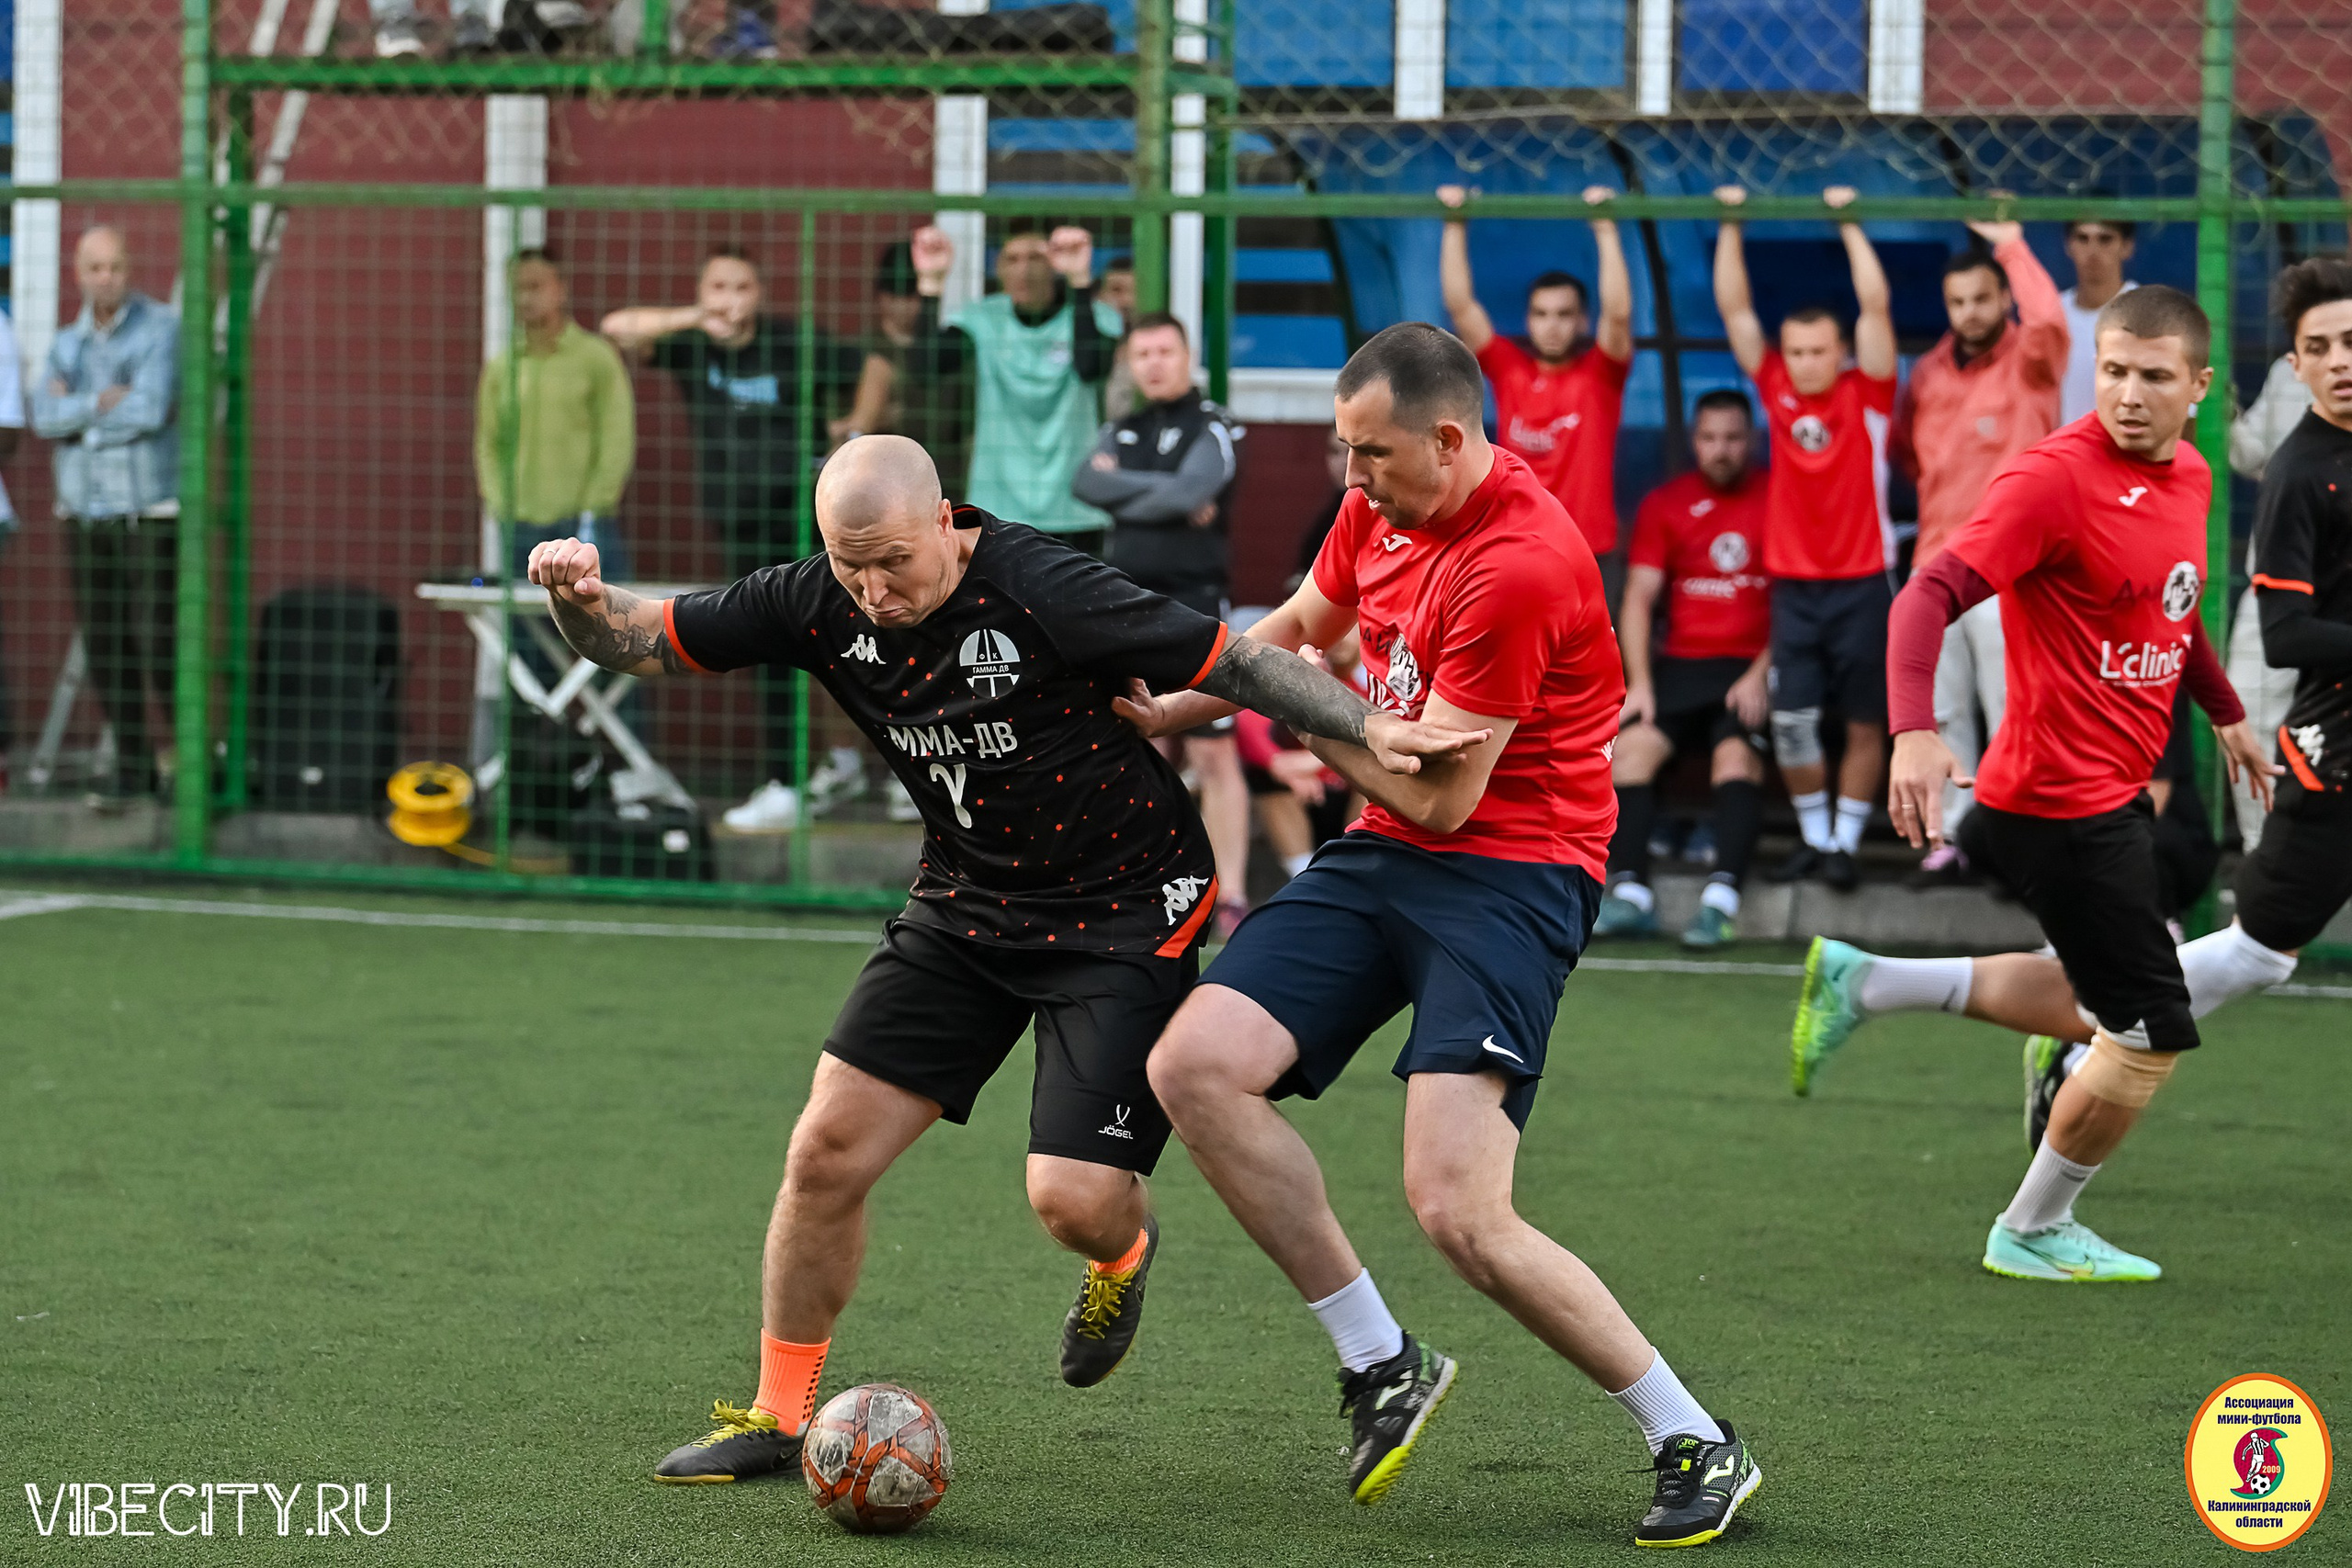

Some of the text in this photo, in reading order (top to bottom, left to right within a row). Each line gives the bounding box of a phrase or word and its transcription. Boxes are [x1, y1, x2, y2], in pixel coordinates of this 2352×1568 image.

[972, 664, 1010, 674] ГАММА ДВ
[886, 721, 1018, 760] ММА-ДВ
[1097, 1124, 1134, 1140] JÖGEL
